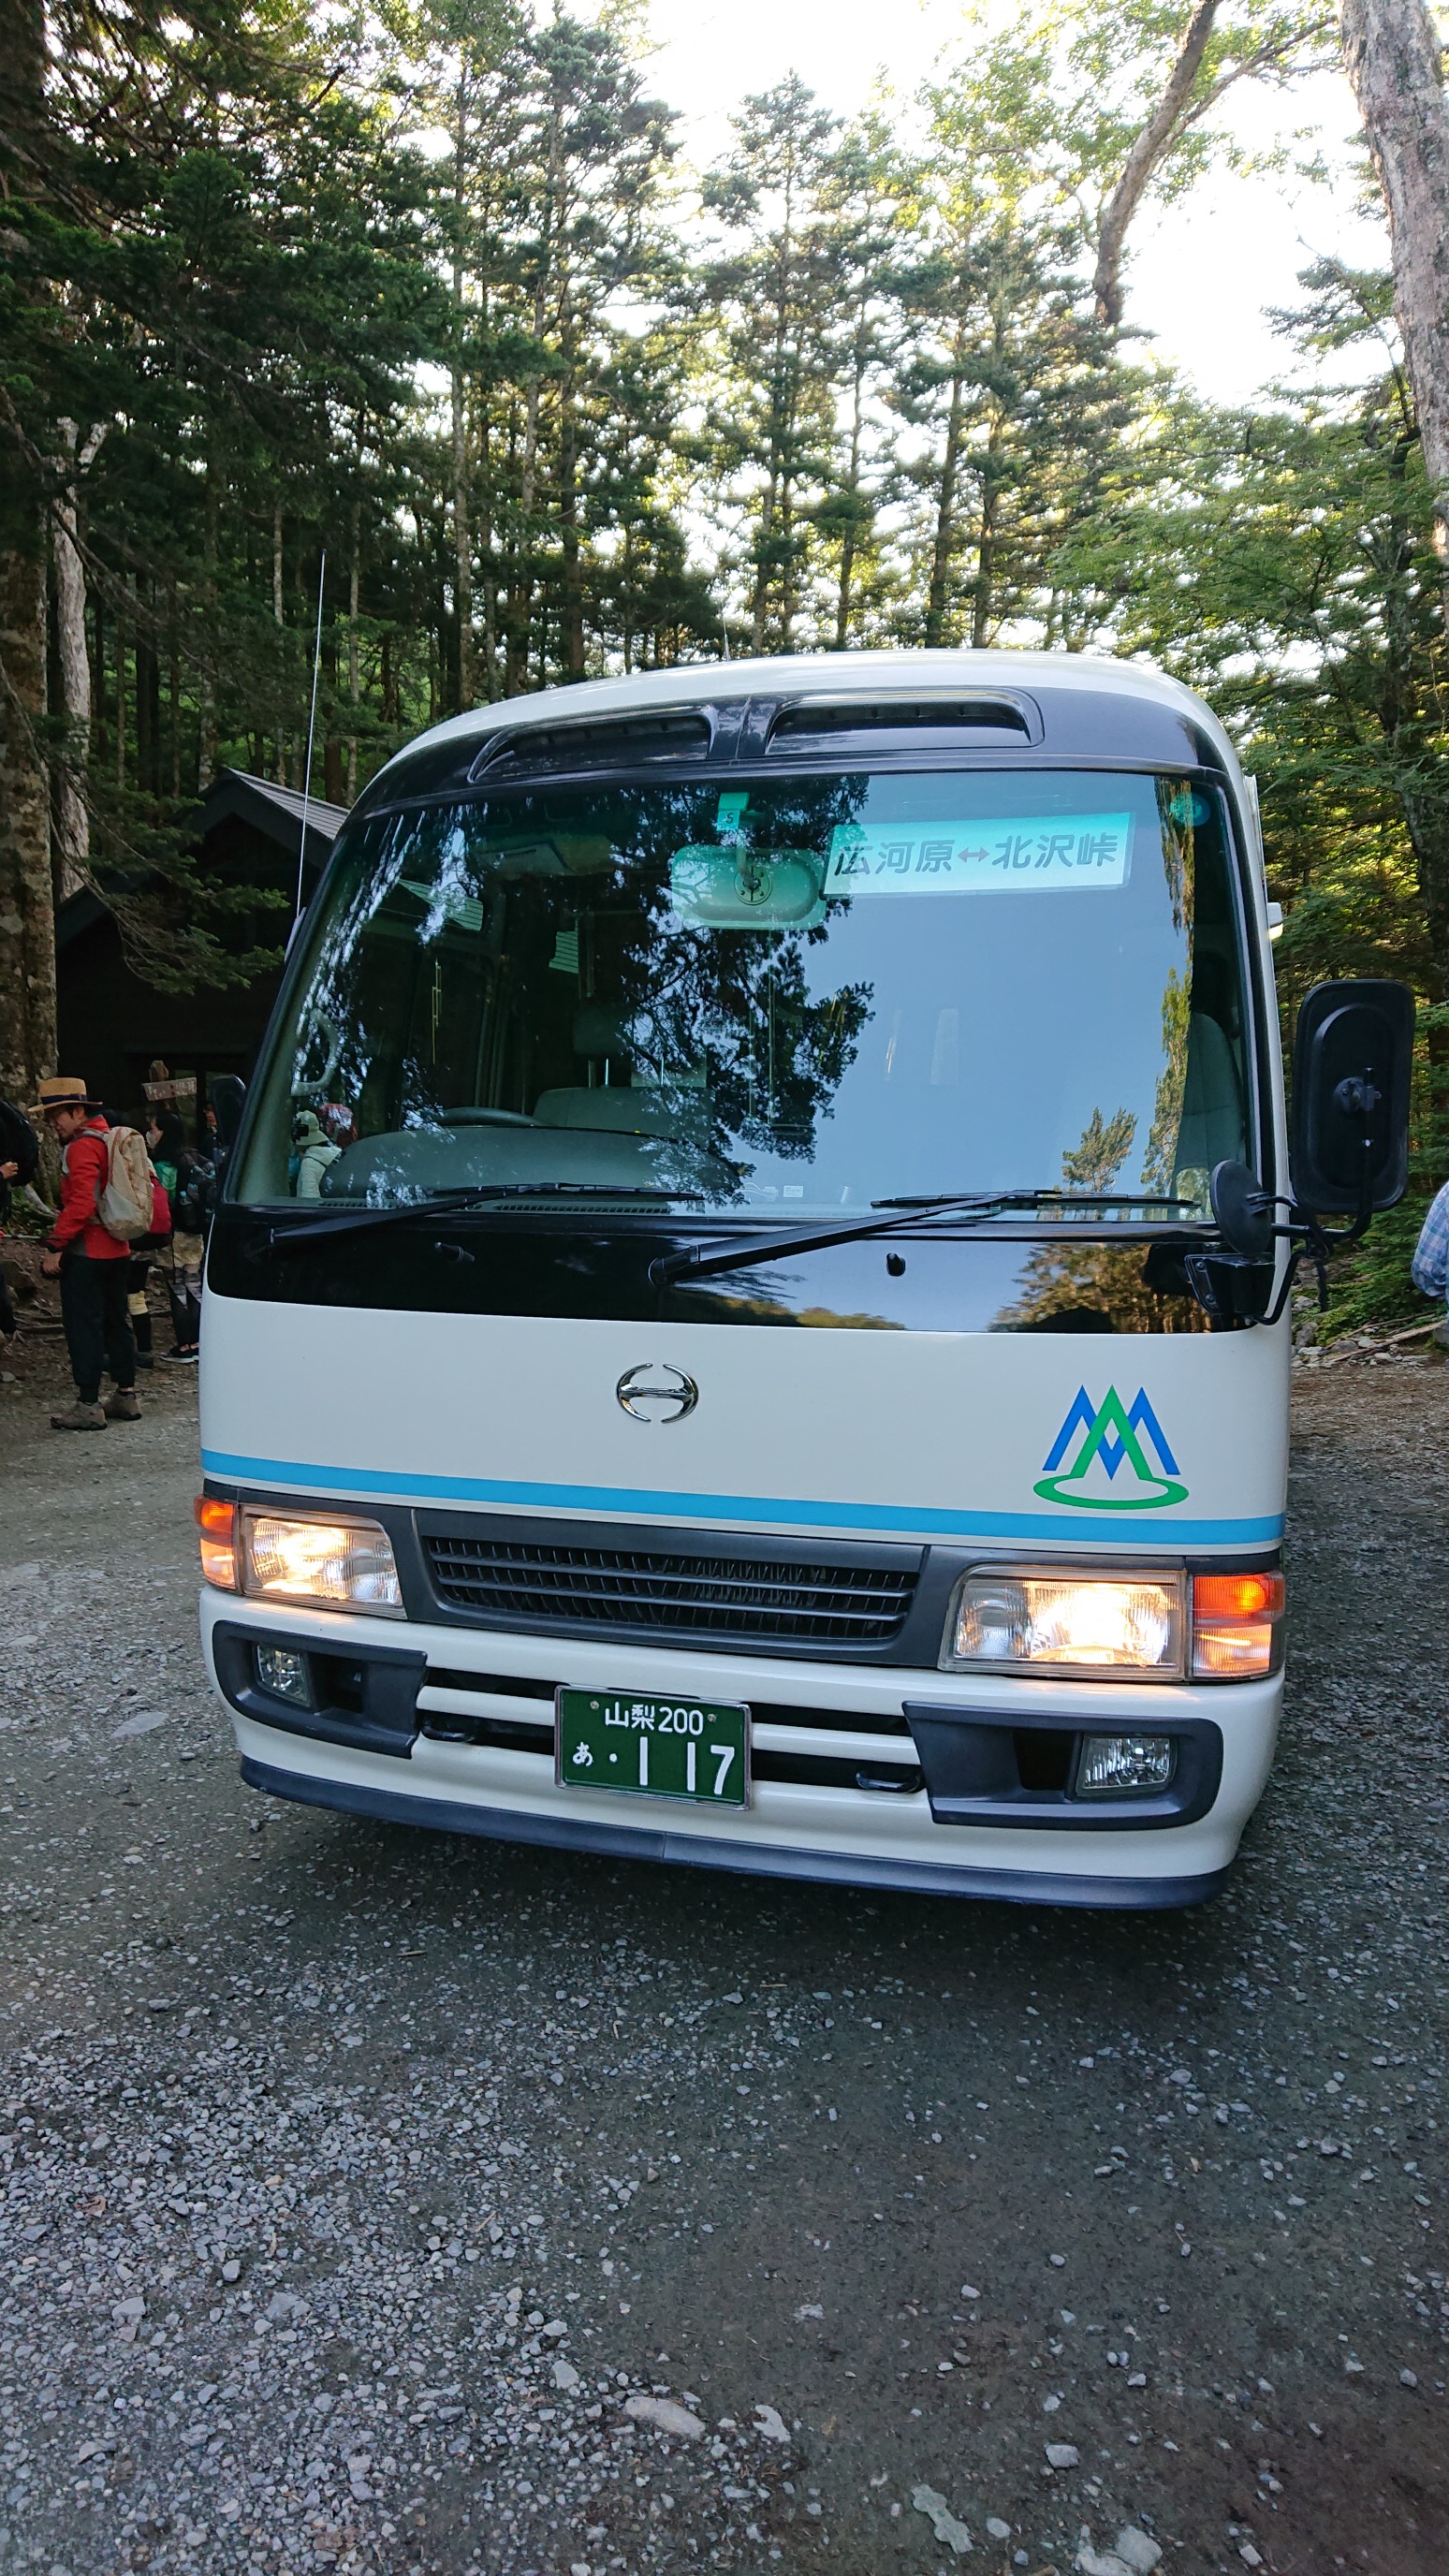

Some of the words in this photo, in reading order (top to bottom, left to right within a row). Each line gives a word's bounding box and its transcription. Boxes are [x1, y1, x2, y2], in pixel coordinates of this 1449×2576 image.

[834, 839, 956, 876] 広河原
[991, 831, 1119, 870] 北沢峠
